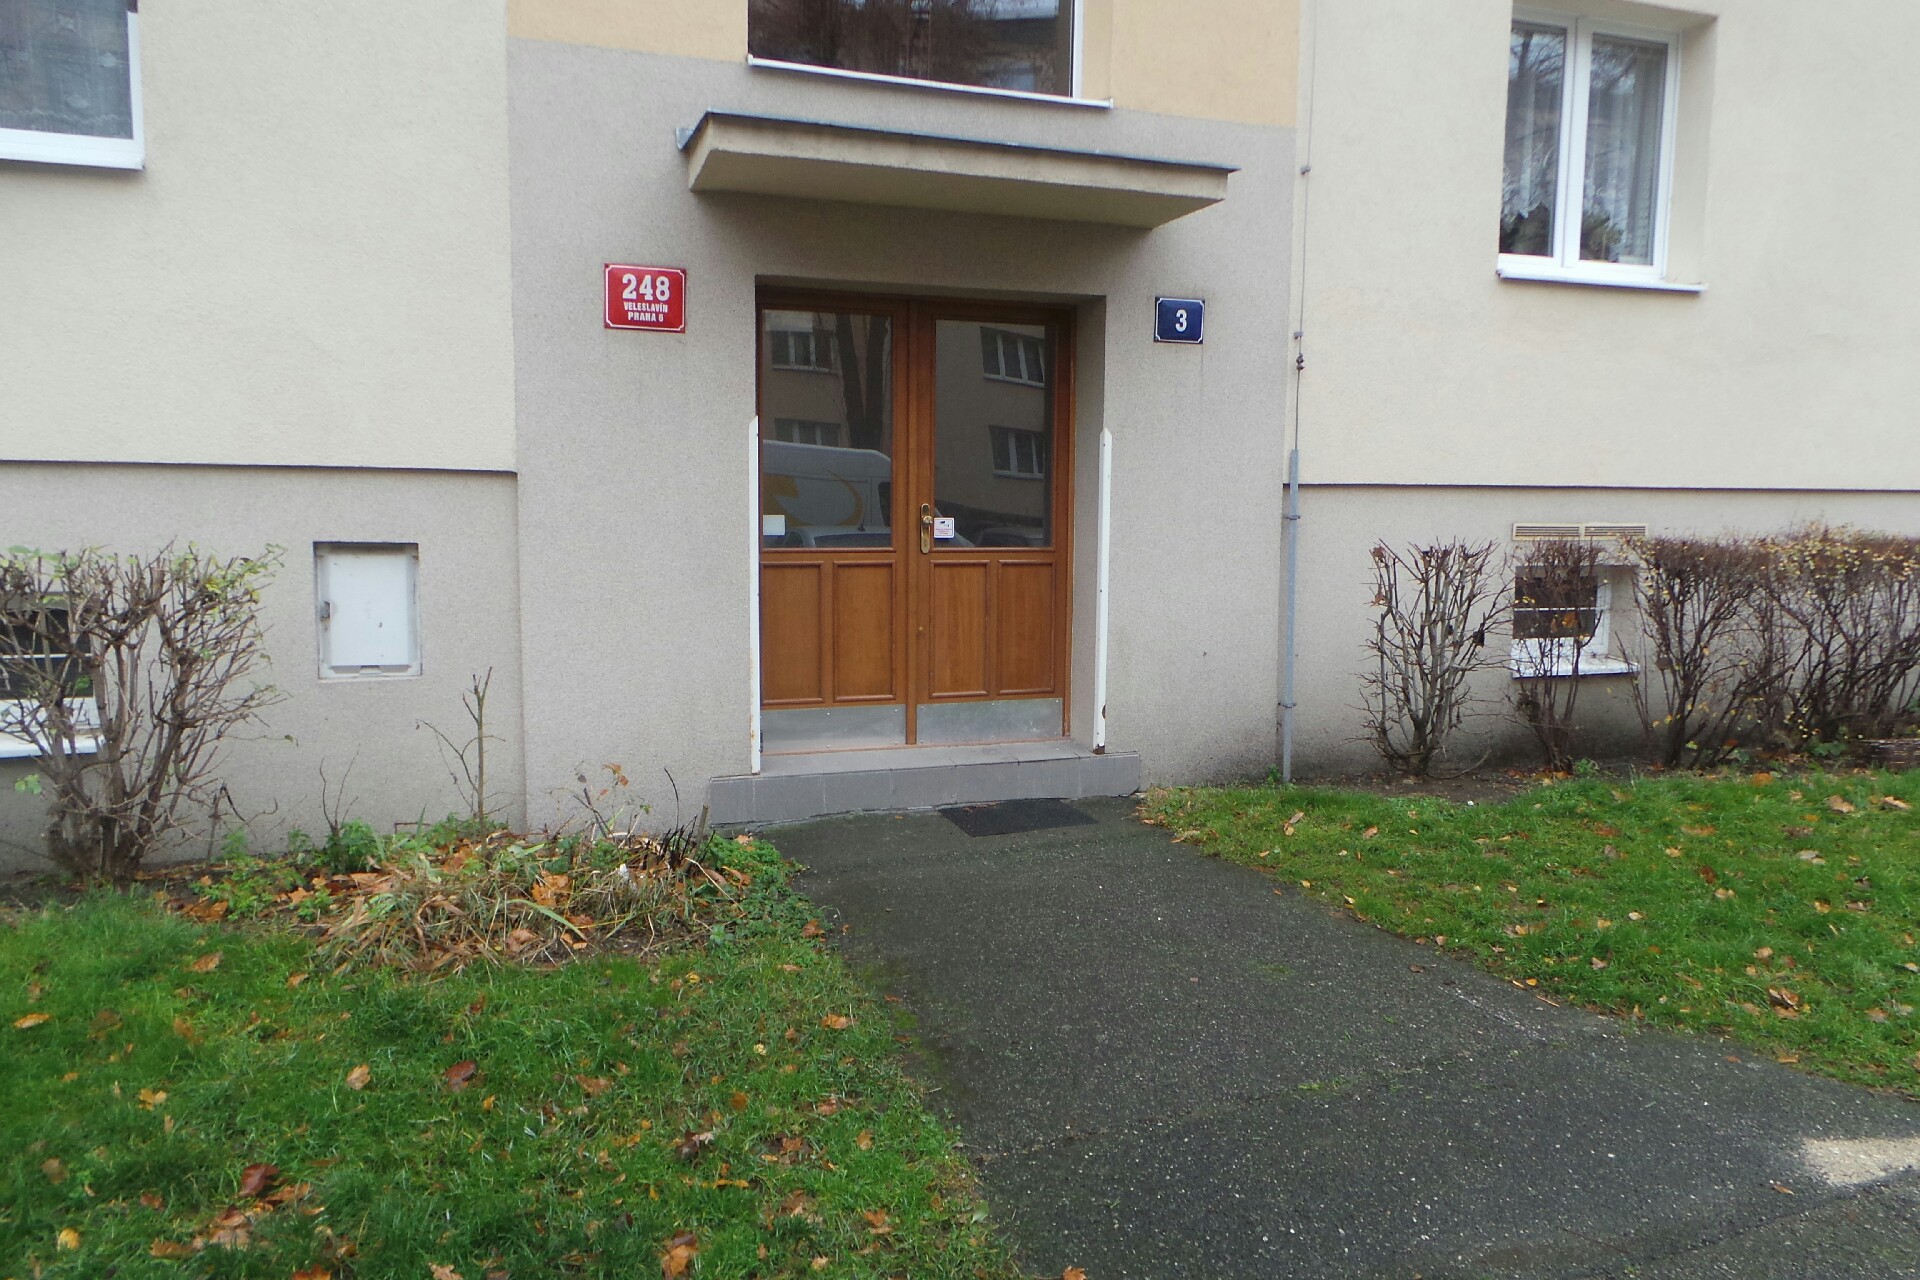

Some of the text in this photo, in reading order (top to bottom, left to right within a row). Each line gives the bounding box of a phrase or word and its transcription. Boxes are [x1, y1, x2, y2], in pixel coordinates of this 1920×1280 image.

[622, 273, 670, 302] 248
[623, 301, 669, 313] VELESLAVÍN
[627, 311, 664, 322] PRAHA 6
[1175, 309, 1187, 332] 3
